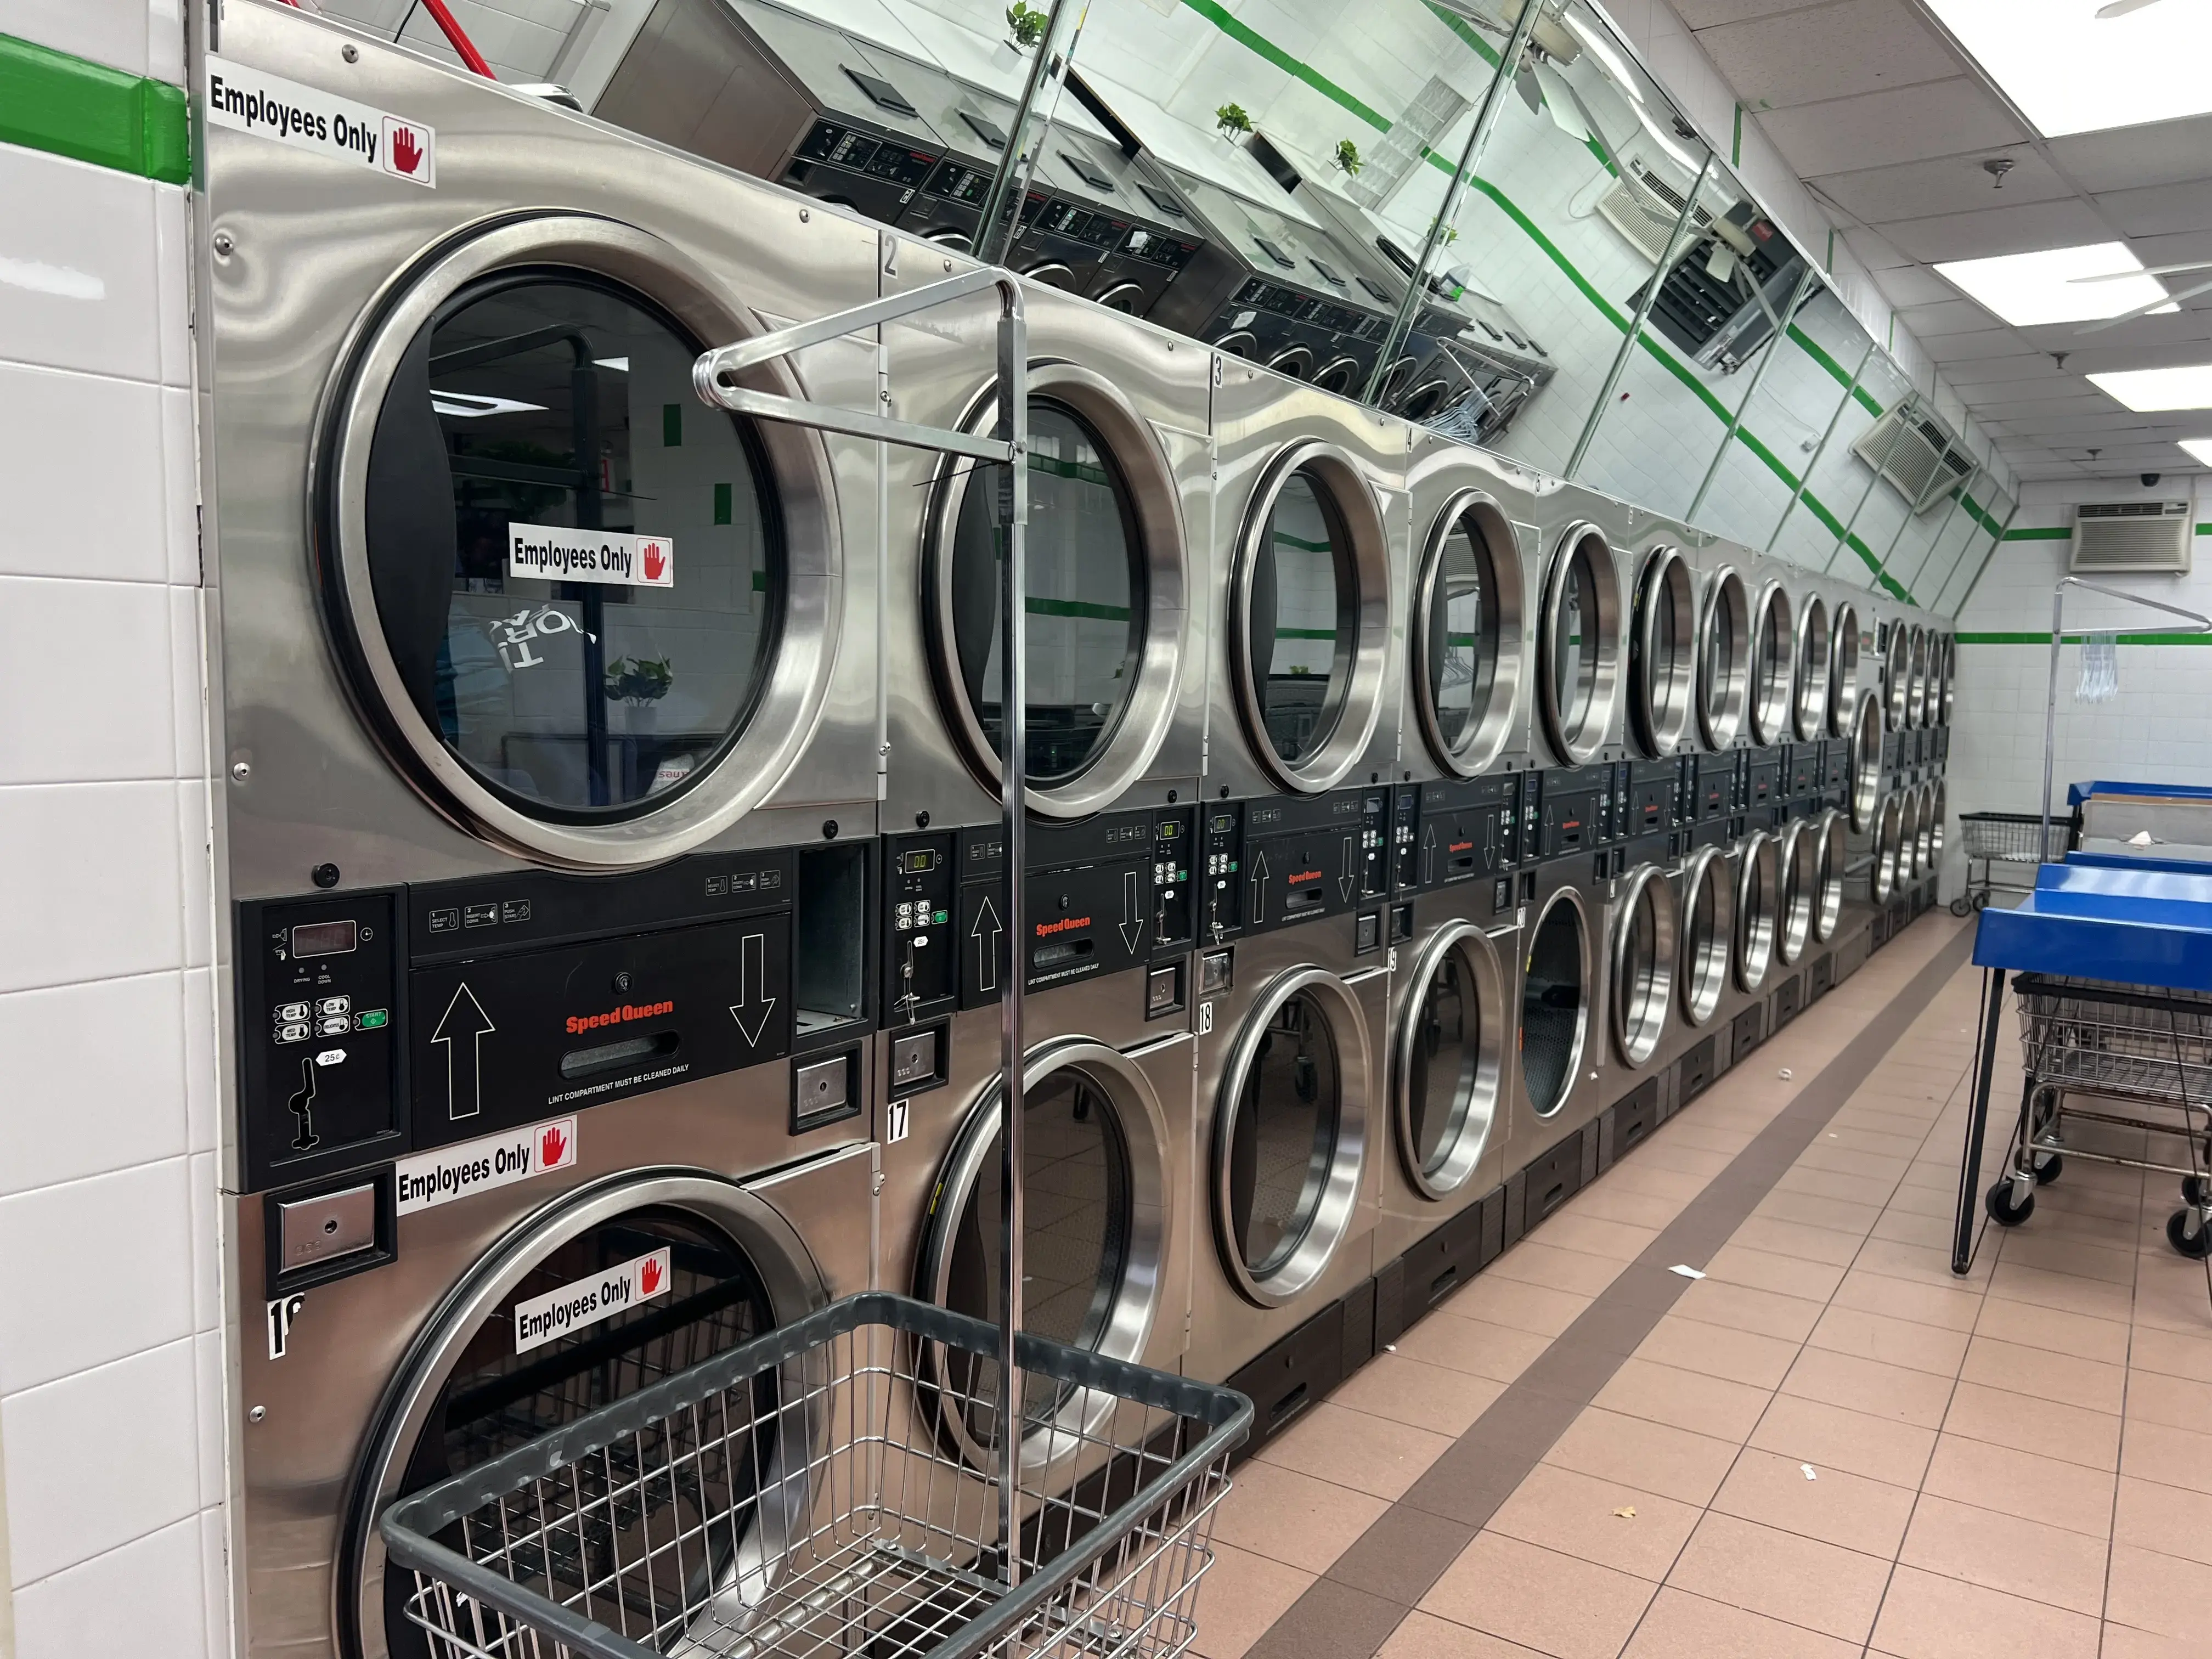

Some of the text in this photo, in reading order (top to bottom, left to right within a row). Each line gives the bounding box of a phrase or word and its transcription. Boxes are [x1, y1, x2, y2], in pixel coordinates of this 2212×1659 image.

[211, 74, 377, 163] Employees Only
[884, 234, 896, 275] 2
[1215, 356, 1222, 386] 3
[515, 538, 632, 578] Employees Only
[1164, 825, 1173, 836] 00
[913, 855, 926, 868] 00
[1036, 917, 1091, 937] Speed Queen
[1036, 973, 1061, 983] COMPARTMENT
[1075, 965, 1090, 974] CLEANED
[566, 1001, 674, 1034] Speed Queen
[1201, 1004, 1211, 1032] 18
[325, 1053, 341, 1062] 25¢
[549, 1064, 689, 1105] LINT COMPARTMENT MUST BE CLEANED DAILY
[889, 1101, 907, 1141] 17
[399, 1143, 530, 1202] Employees Only
[520, 1276, 631, 1340] Employees Only
